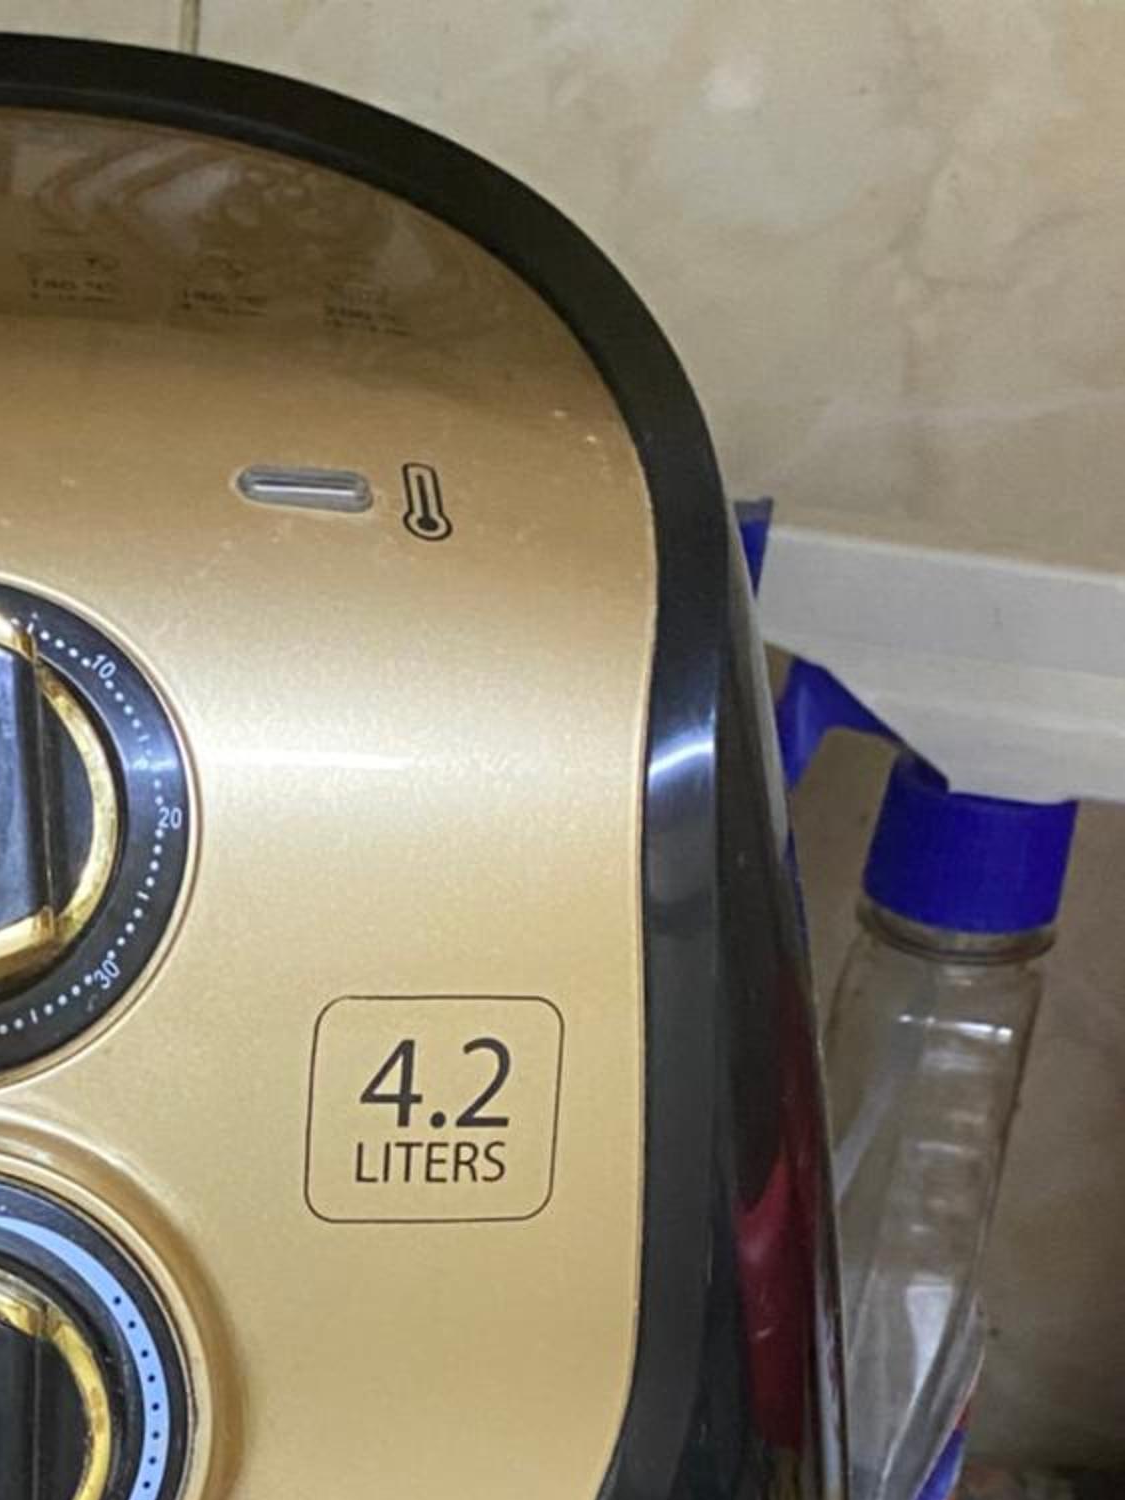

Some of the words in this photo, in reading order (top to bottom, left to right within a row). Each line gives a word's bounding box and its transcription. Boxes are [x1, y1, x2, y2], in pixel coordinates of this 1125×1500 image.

[90, 653, 117, 679] 10
[158, 806, 183, 830] 20
[93, 959, 120, 989] 30
[359, 1036, 511, 1129] 4.2
[354, 1140, 507, 1184] LITERS
